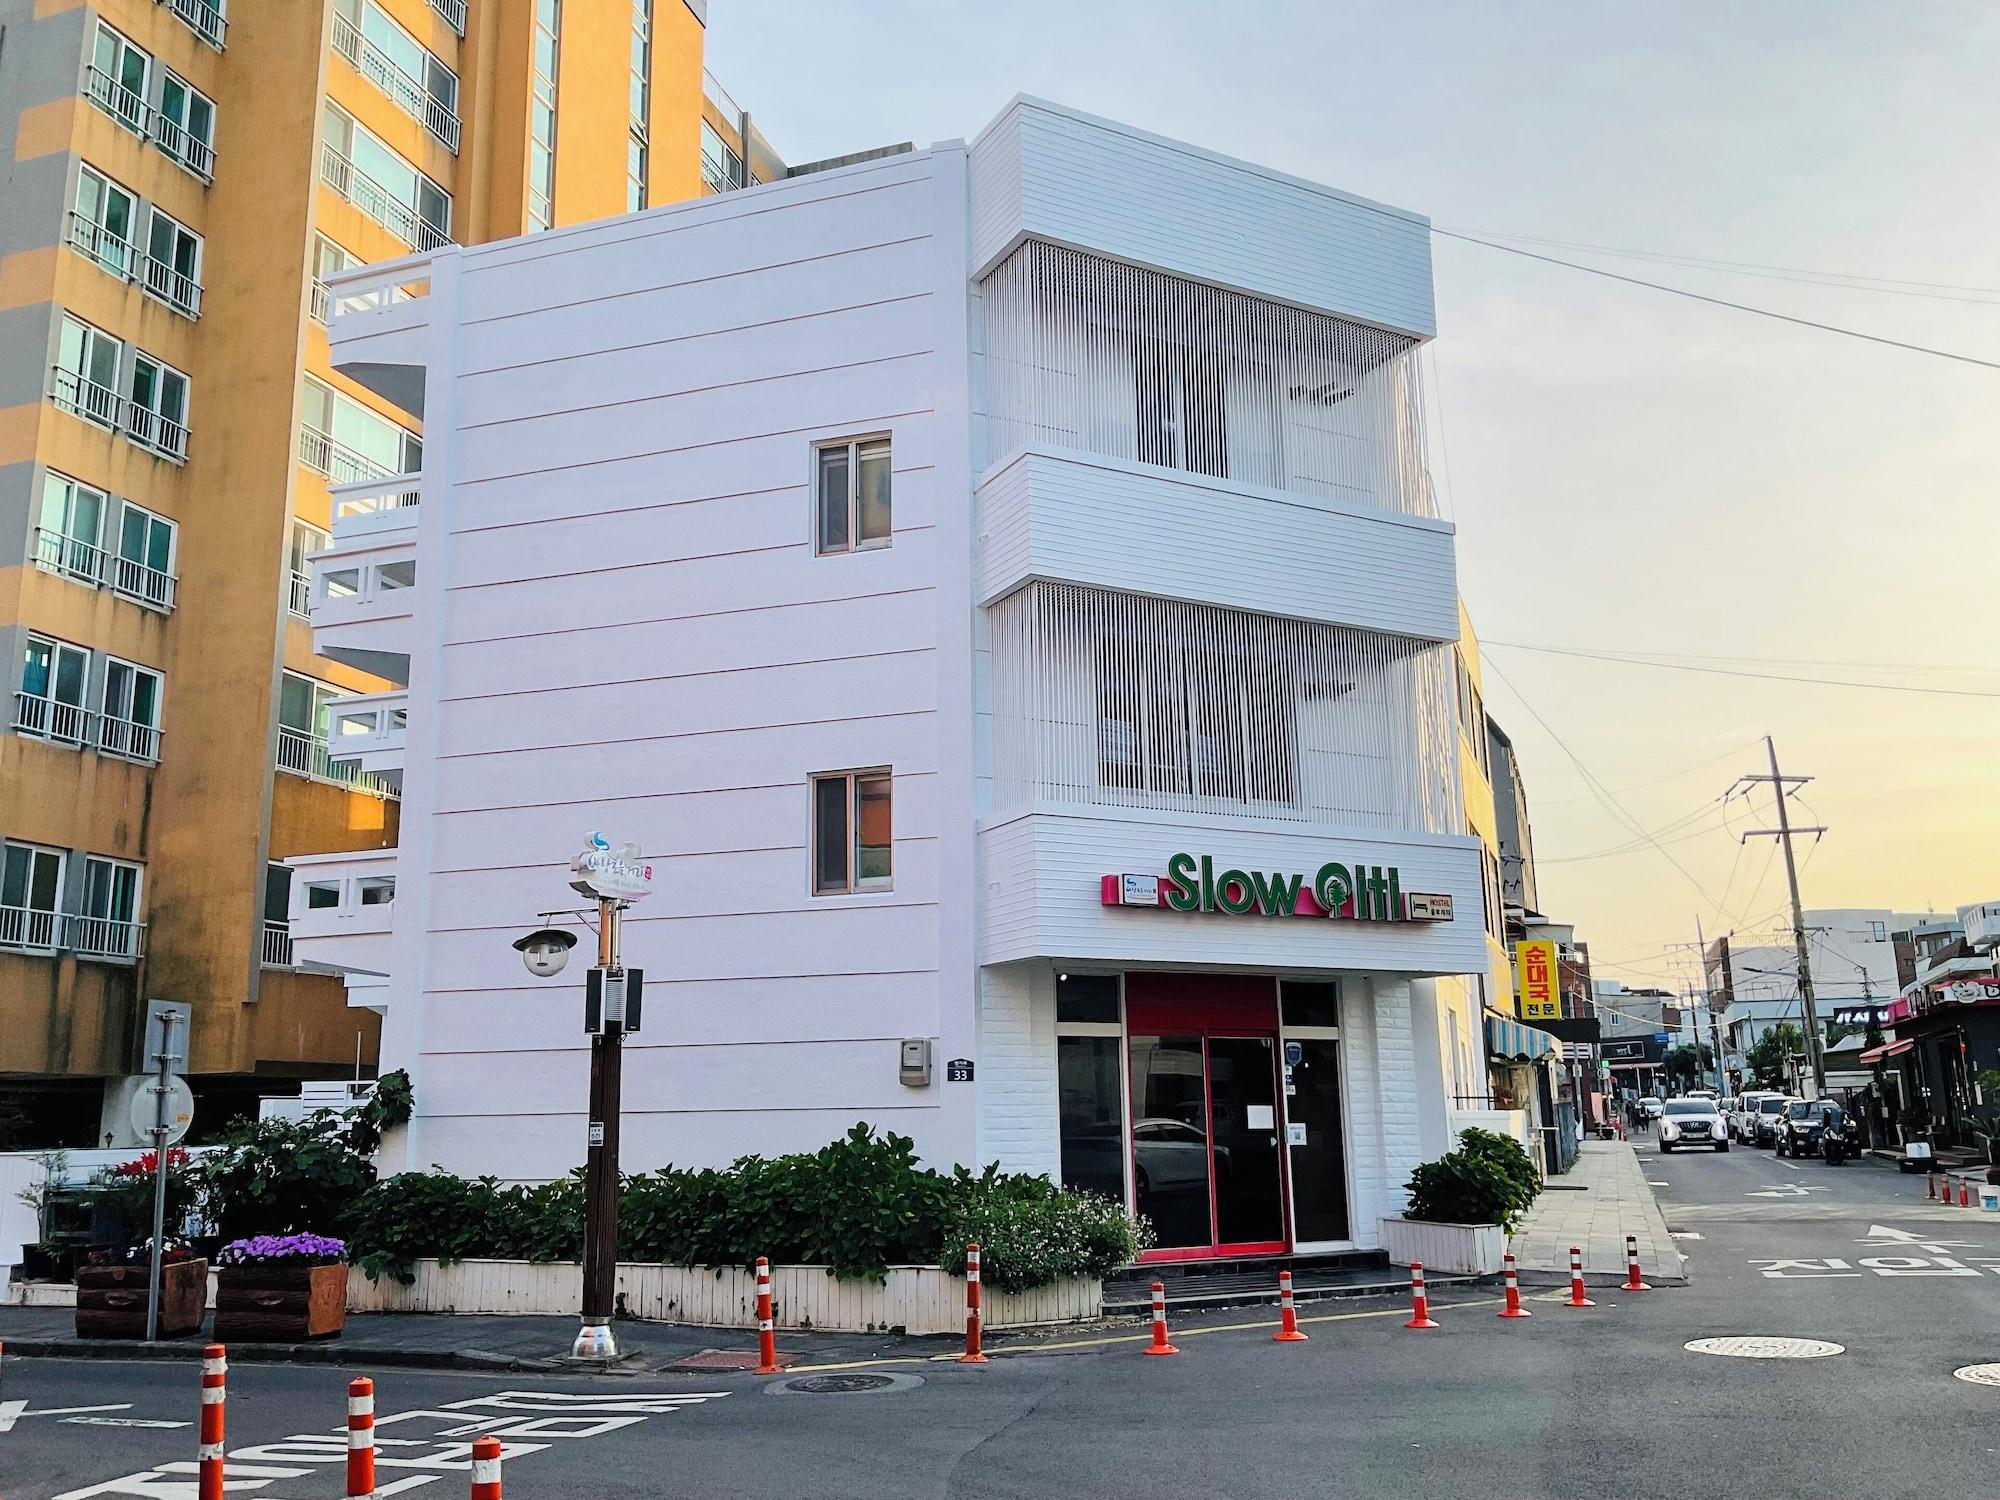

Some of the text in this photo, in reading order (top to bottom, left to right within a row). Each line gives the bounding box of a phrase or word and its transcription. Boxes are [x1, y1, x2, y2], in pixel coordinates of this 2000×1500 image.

[1164, 853, 1304, 916] Slow
[1525, 946, 1550, 1002] 순대국
[1527, 1003, 1555, 1015] 전문
[953, 1070, 968, 1080] 33
